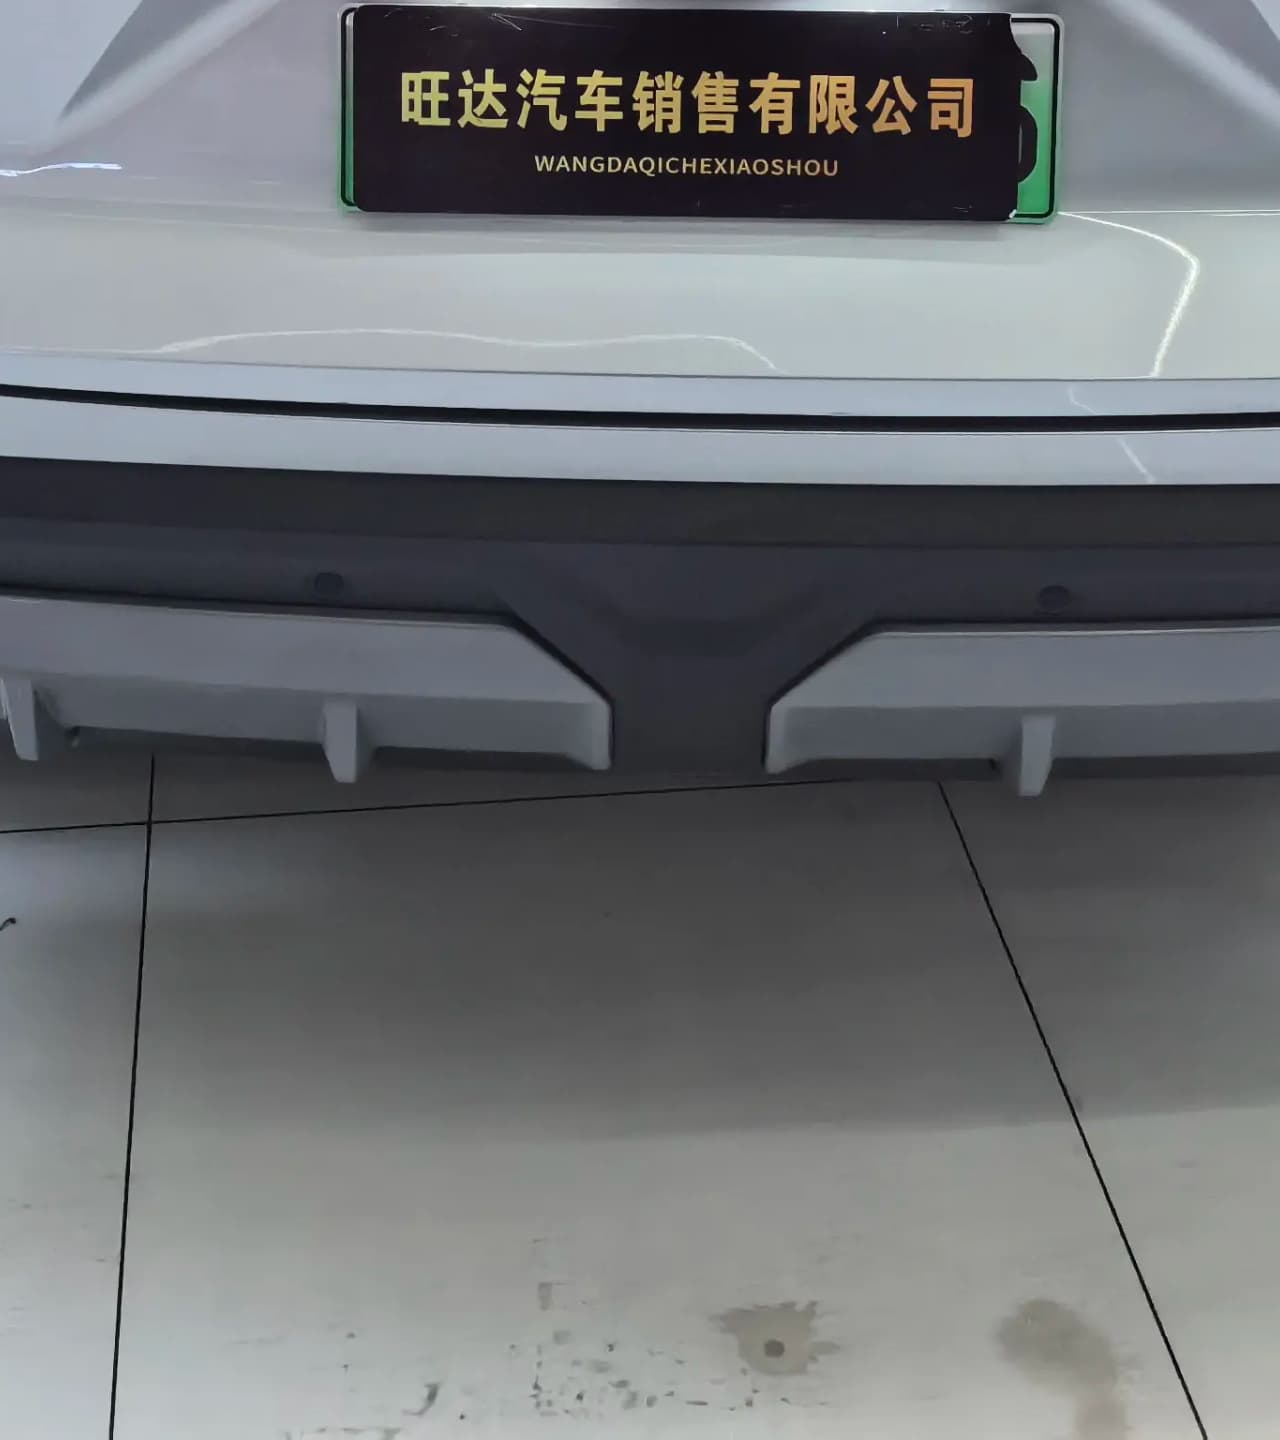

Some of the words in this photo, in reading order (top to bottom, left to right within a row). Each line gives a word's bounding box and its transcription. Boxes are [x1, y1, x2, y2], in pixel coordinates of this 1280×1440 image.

[400, 67, 976, 140] 旺达汽车销售有限公司
[534, 154, 840, 179] WANGDAQICHEXIAOSHOU
